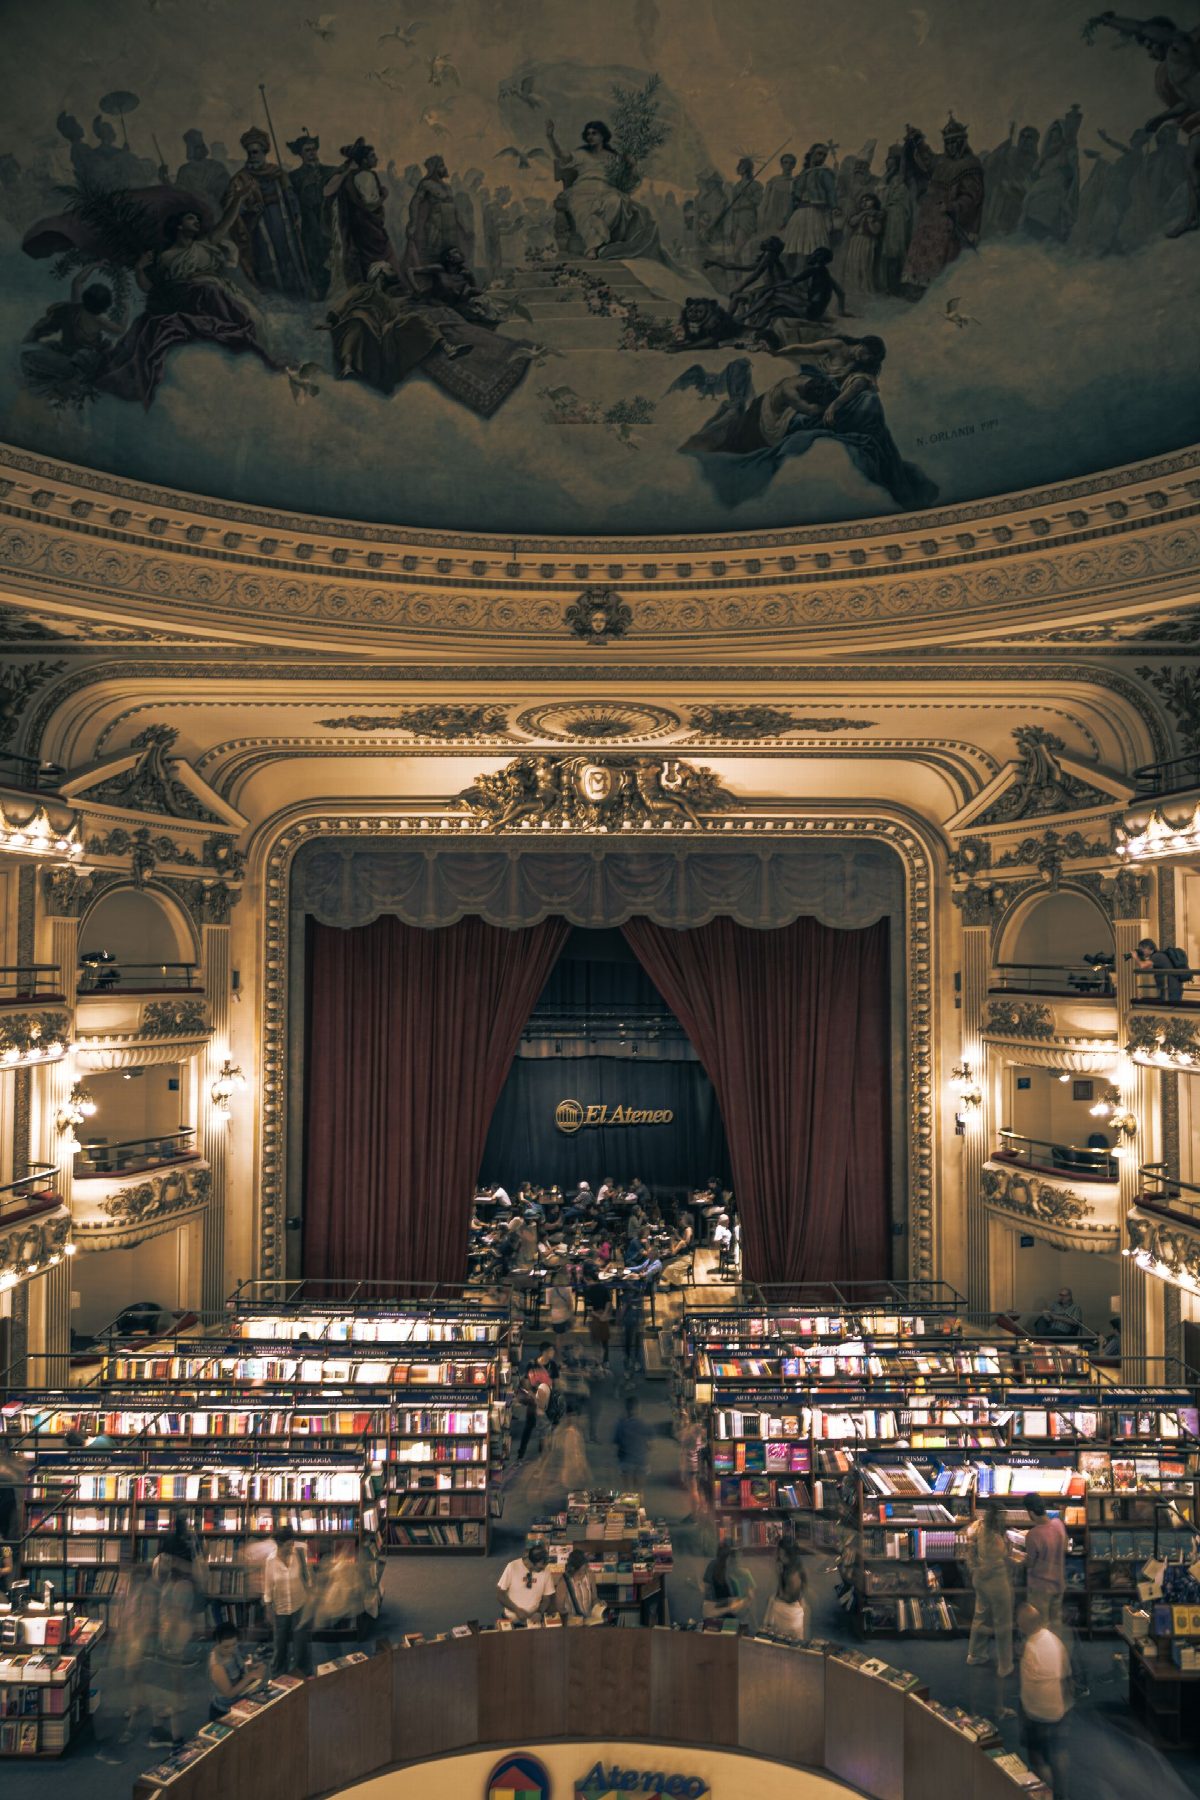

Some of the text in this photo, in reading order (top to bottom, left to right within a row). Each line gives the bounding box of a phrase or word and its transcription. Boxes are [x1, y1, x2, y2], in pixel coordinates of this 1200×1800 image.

[584, 1104, 674, 1124] El Ateneo
[897, 1455, 928, 1463] TURISMO
[580, 1760, 711, 1798] Ateneo
